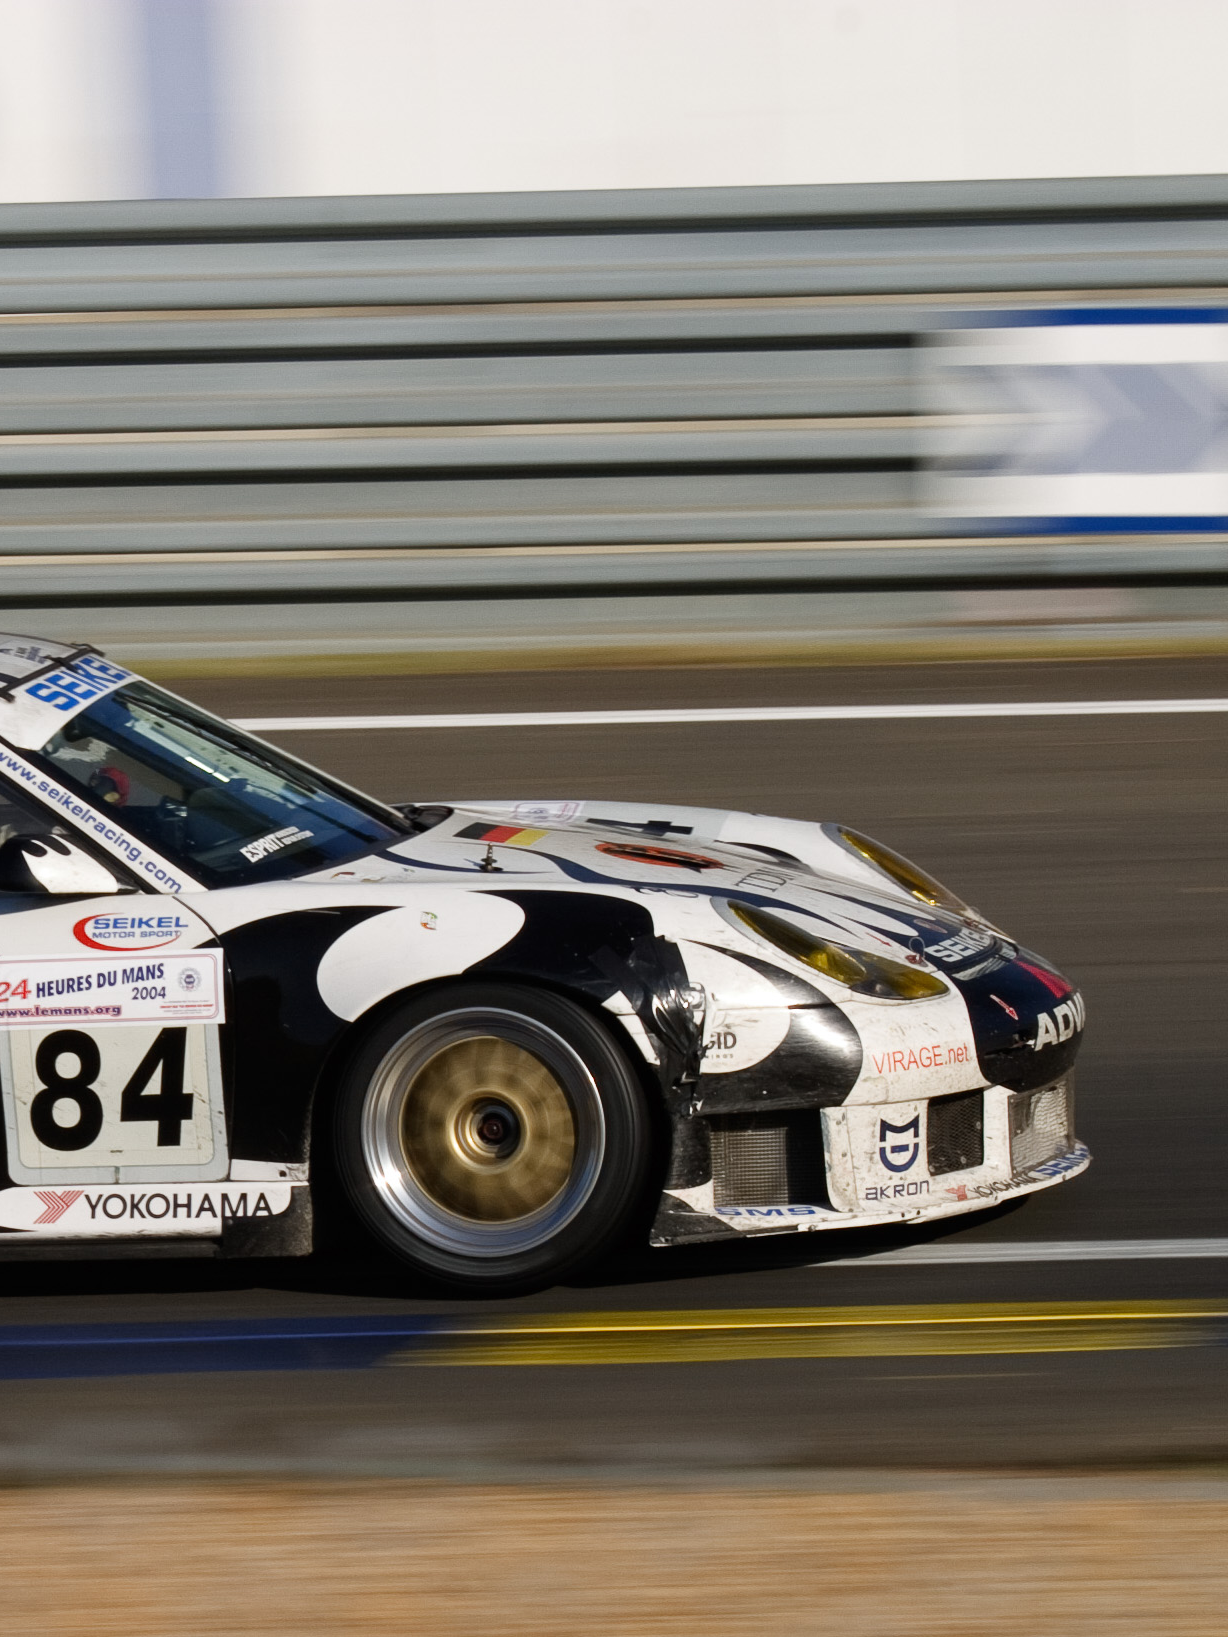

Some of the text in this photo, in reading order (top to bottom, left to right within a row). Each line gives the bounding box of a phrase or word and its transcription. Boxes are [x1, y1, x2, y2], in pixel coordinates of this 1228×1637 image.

[239, 833, 286, 863] ESPRIT
[92, 916, 190, 930] SEIKEL
[92, 930, 183, 940] MOTOR SPORT
[36, 974, 93, 999] HEURES
[96, 970, 118, 989] DU
[121, 962, 165, 985] MANS
[131, 986, 167, 1001] 2004
[872, 1042, 970, 1075] VIRAGE.net
[30, 1026, 194, 1152] 84
[84, 1193, 274, 1220] YOKOHAMA
